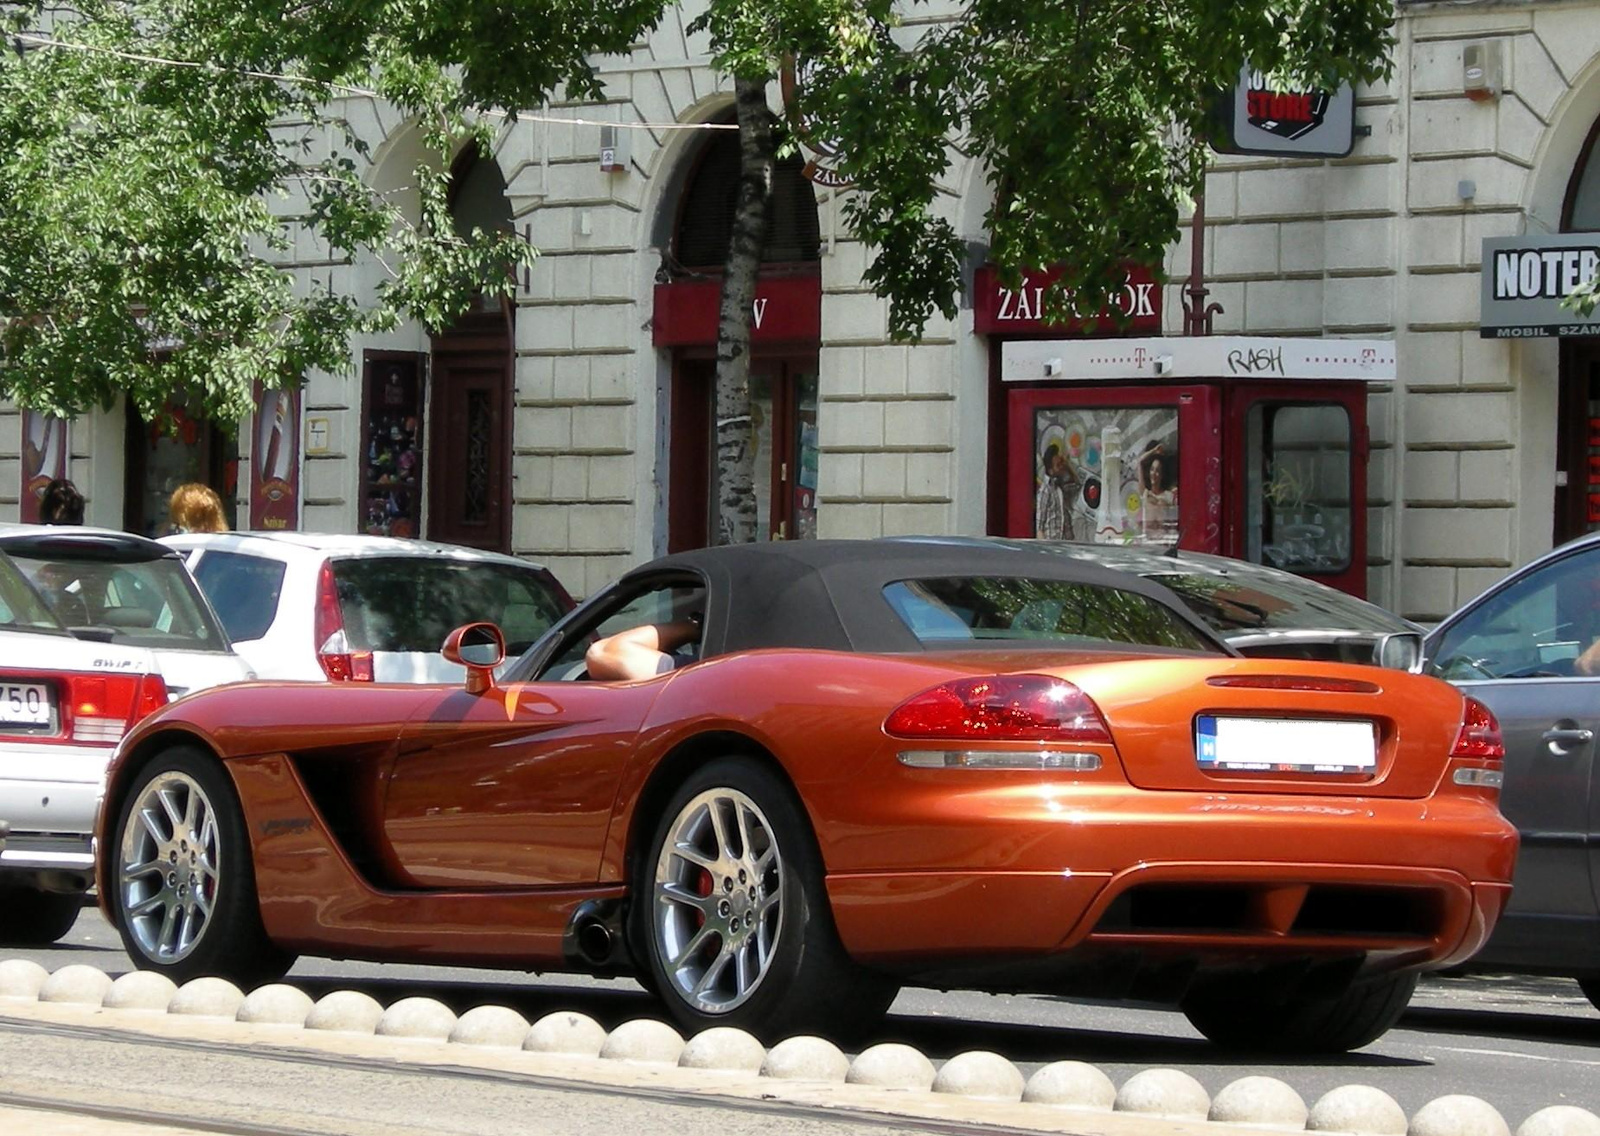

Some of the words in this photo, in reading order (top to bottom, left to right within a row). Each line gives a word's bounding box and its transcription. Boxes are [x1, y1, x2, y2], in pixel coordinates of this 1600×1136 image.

[1247, 92, 1313, 121] STORE
[1497, 327, 1550, 337] MOBIL
[1228, 346, 1285, 376] RASH
